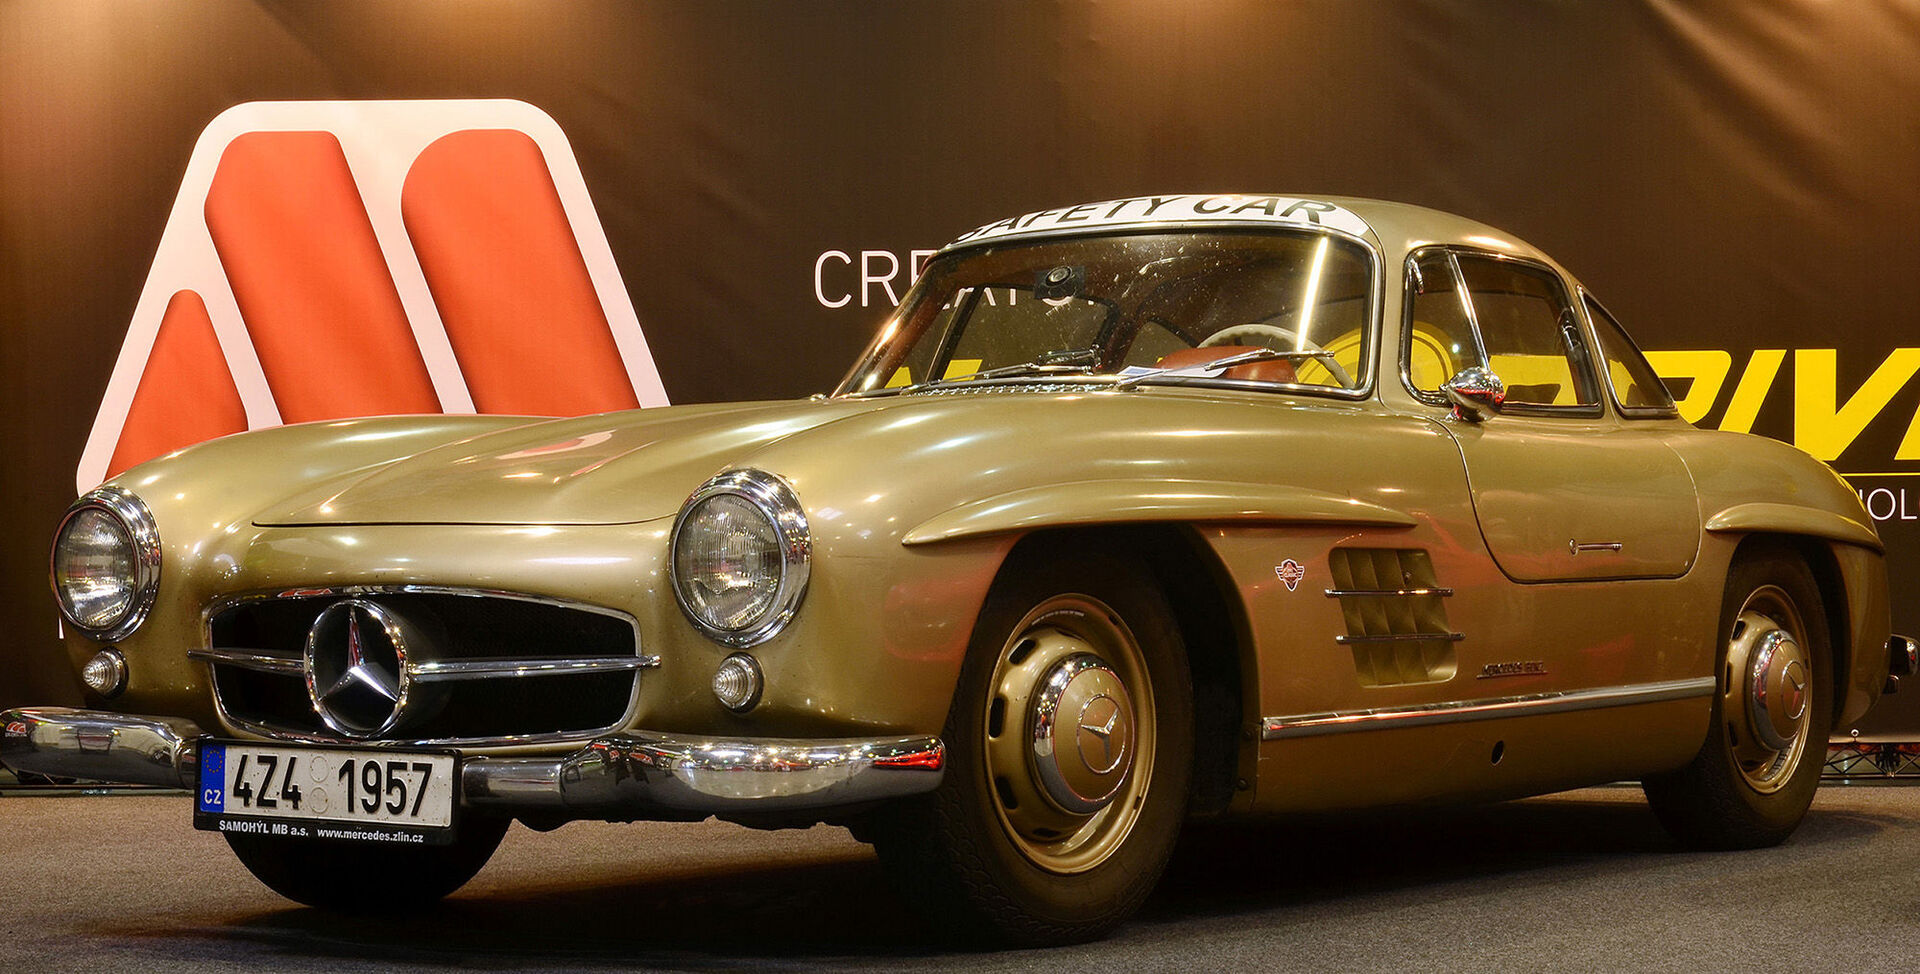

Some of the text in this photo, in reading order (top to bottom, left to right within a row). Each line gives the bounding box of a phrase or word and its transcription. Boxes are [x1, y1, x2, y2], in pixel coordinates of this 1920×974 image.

[950, 197, 1336, 244] SAFETY CAR
[204, 788, 221, 804] CZ
[233, 753, 433, 817] 4Z4 1957
[219, 819, 424, 843] SAMOHÝL MB a.s. www.mercedes.zlin.cz
